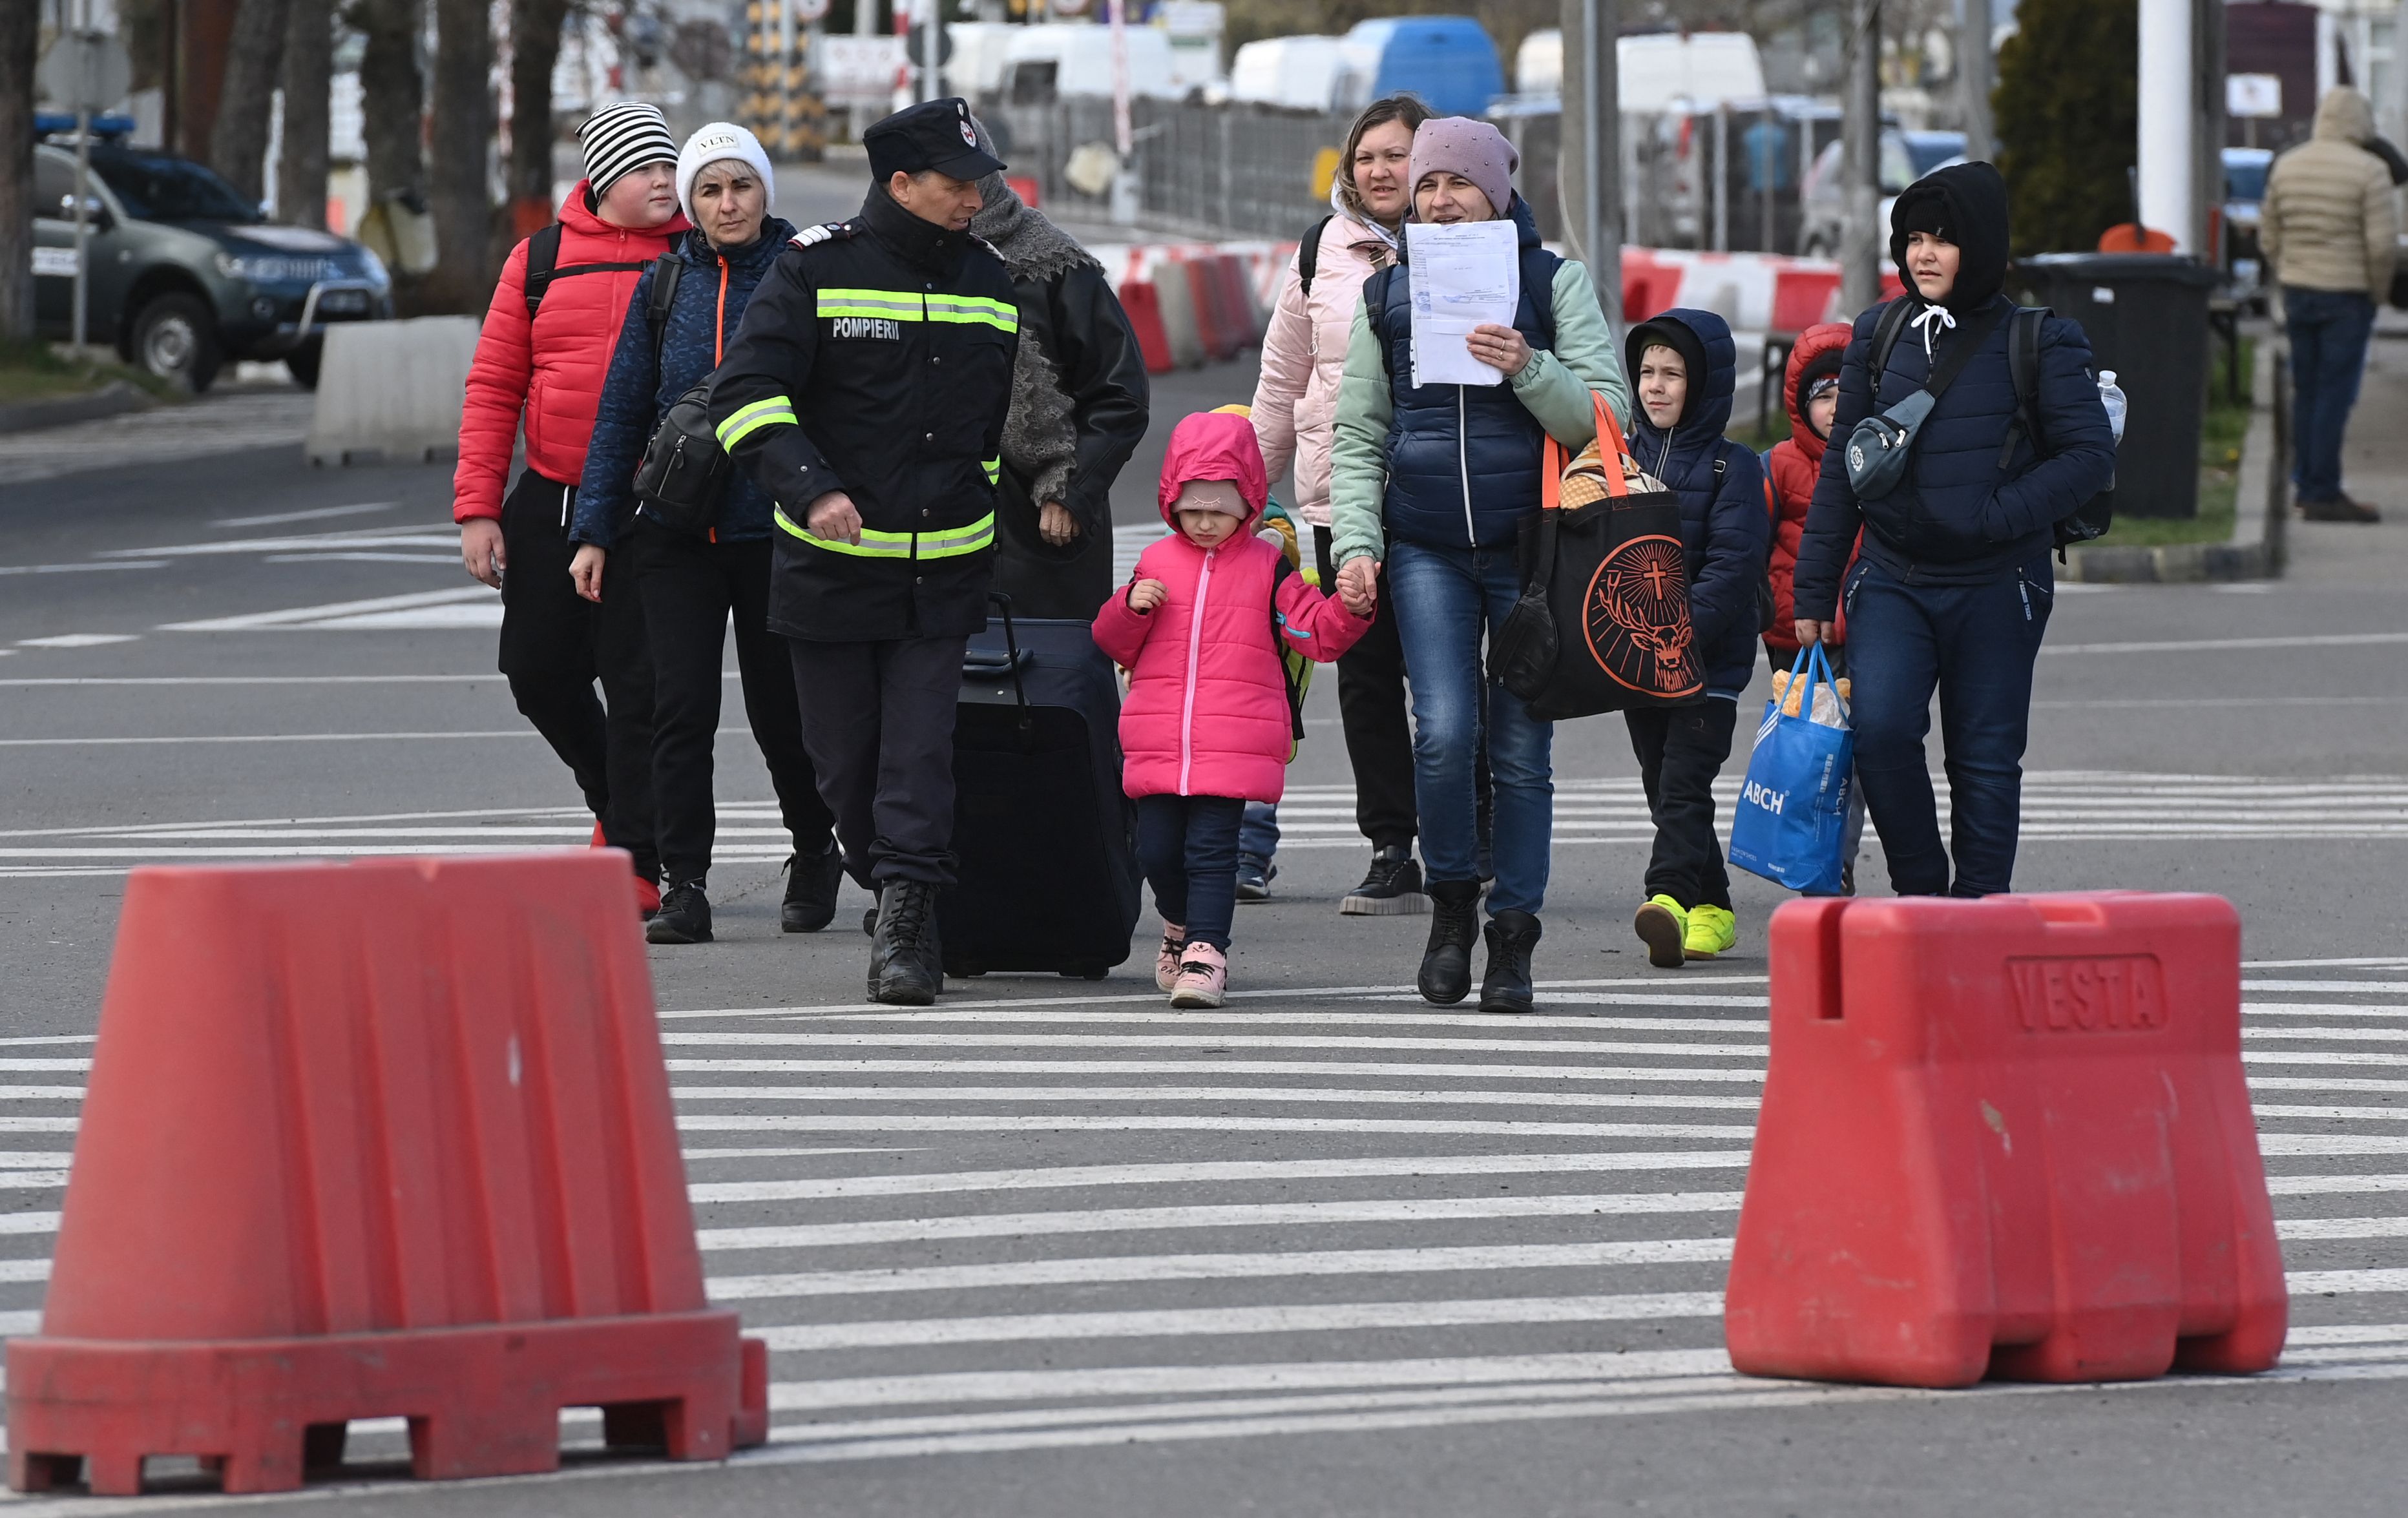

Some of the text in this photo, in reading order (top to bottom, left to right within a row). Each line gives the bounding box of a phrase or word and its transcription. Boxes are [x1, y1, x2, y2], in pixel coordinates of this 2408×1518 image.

[700, 135, 735, 149] VLTN
[833, 317, 899, 341] POMPIERII
[1743, 779, 1785, 815] ABCH
[1833, 776, 1848, 815] ABCH
[2007, 961, 2159, 1032] VESTA
